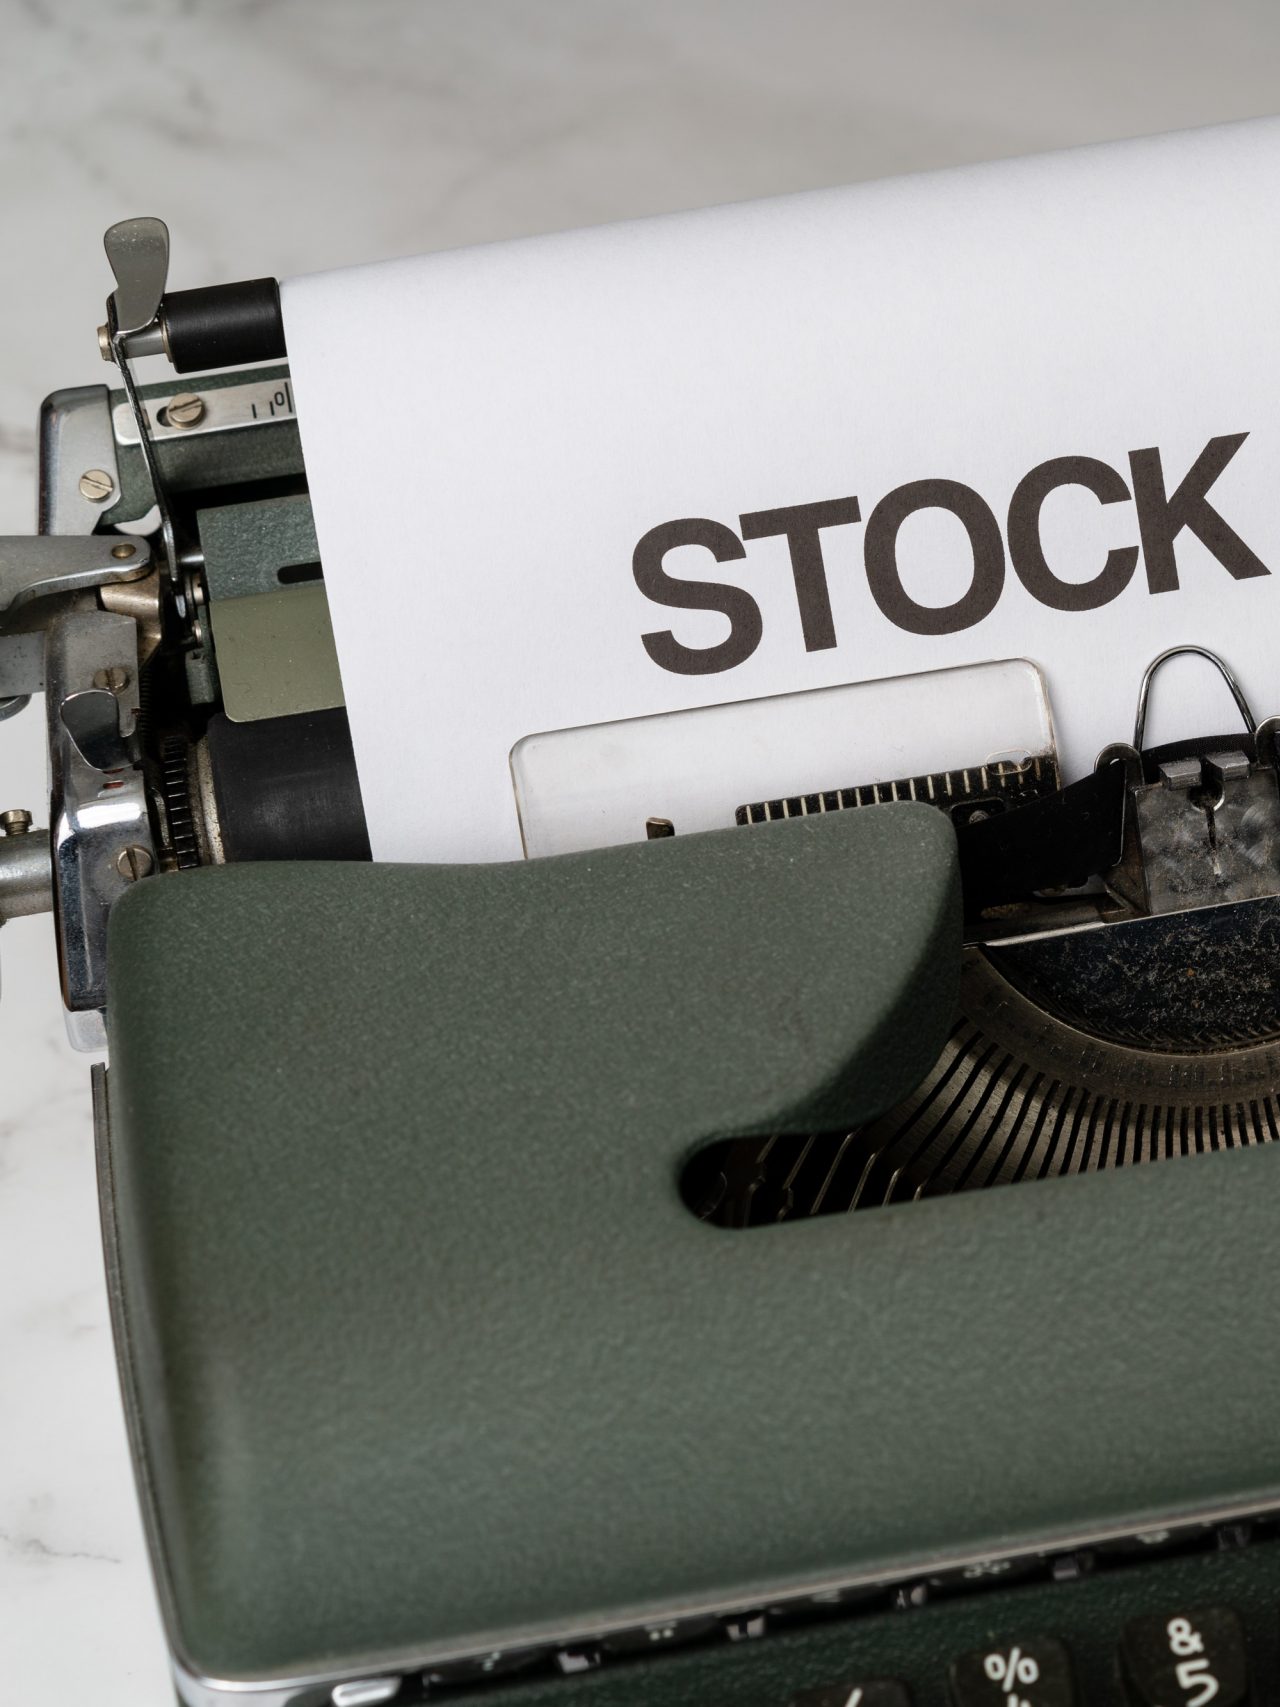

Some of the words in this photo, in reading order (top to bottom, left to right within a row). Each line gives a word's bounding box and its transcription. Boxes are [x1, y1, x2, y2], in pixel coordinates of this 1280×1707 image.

[632, 432, 1272, 675] STOCK
[1167, 1617, 1204, 1656] &
[984, 1647, 1039, 1692] %
[1175, 1658, 1219, 1707] 5
